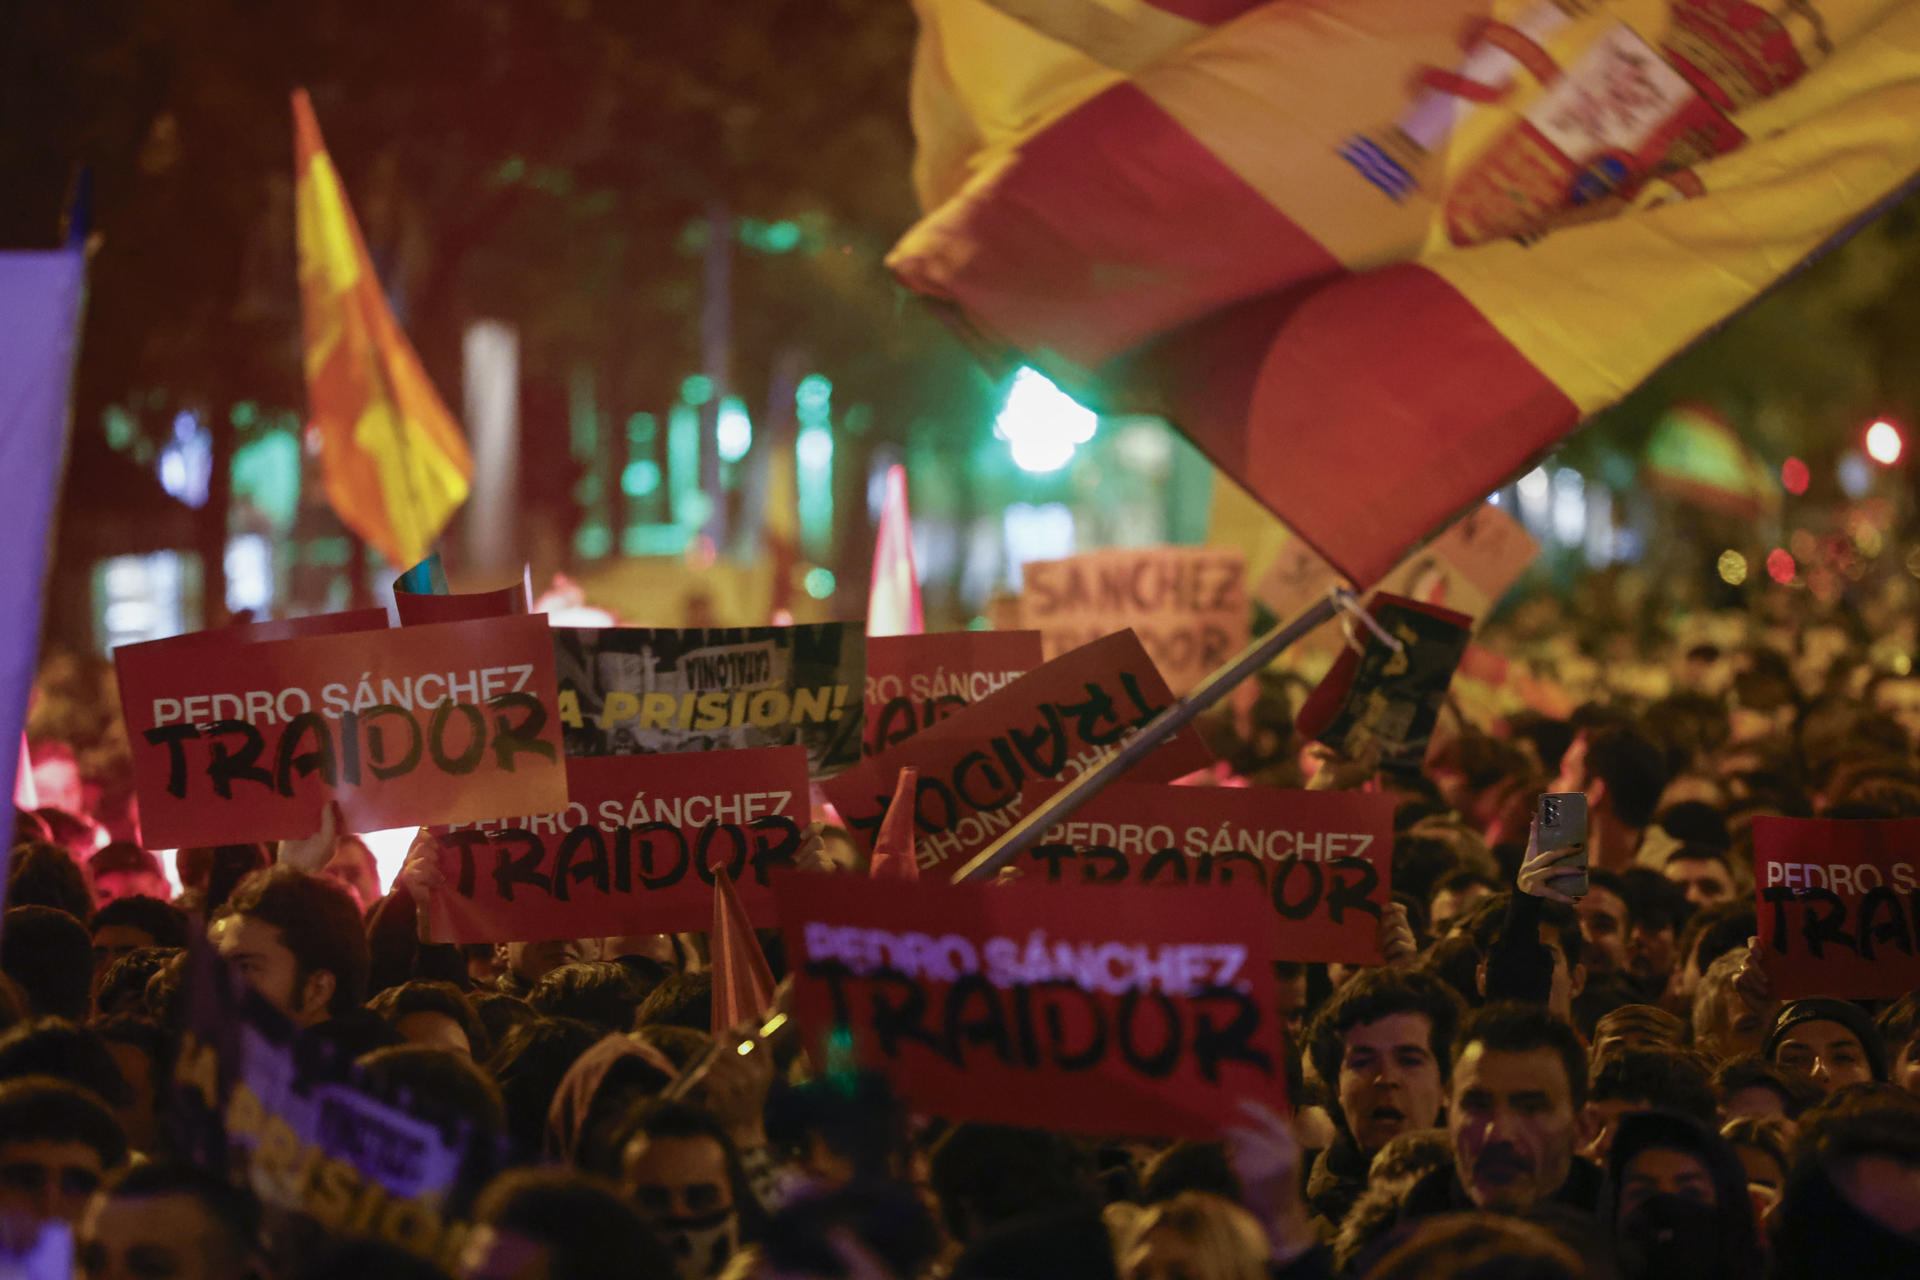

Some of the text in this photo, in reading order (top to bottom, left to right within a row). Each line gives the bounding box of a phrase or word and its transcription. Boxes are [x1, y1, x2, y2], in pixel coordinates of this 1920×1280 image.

[153, 664, 537, 730] PEDRO SÁNCHEZ
[600, 679, 849, 731] PRISIÓN!
[143, 691, 558, 799] TRAIDOR
[599, 791, 794, 833] SÁNCHEZ
[1183, 821, 1374, 863] SÁNCHEZ
[440, 815, 802, 901] TRAIDOR
[1767, 861, 1920, 895] PEDRO S
[804, 921, 1254, 996] PEDRO SÁNCHEZ
[804, 959, 1273, 1083] TRAIDOR
